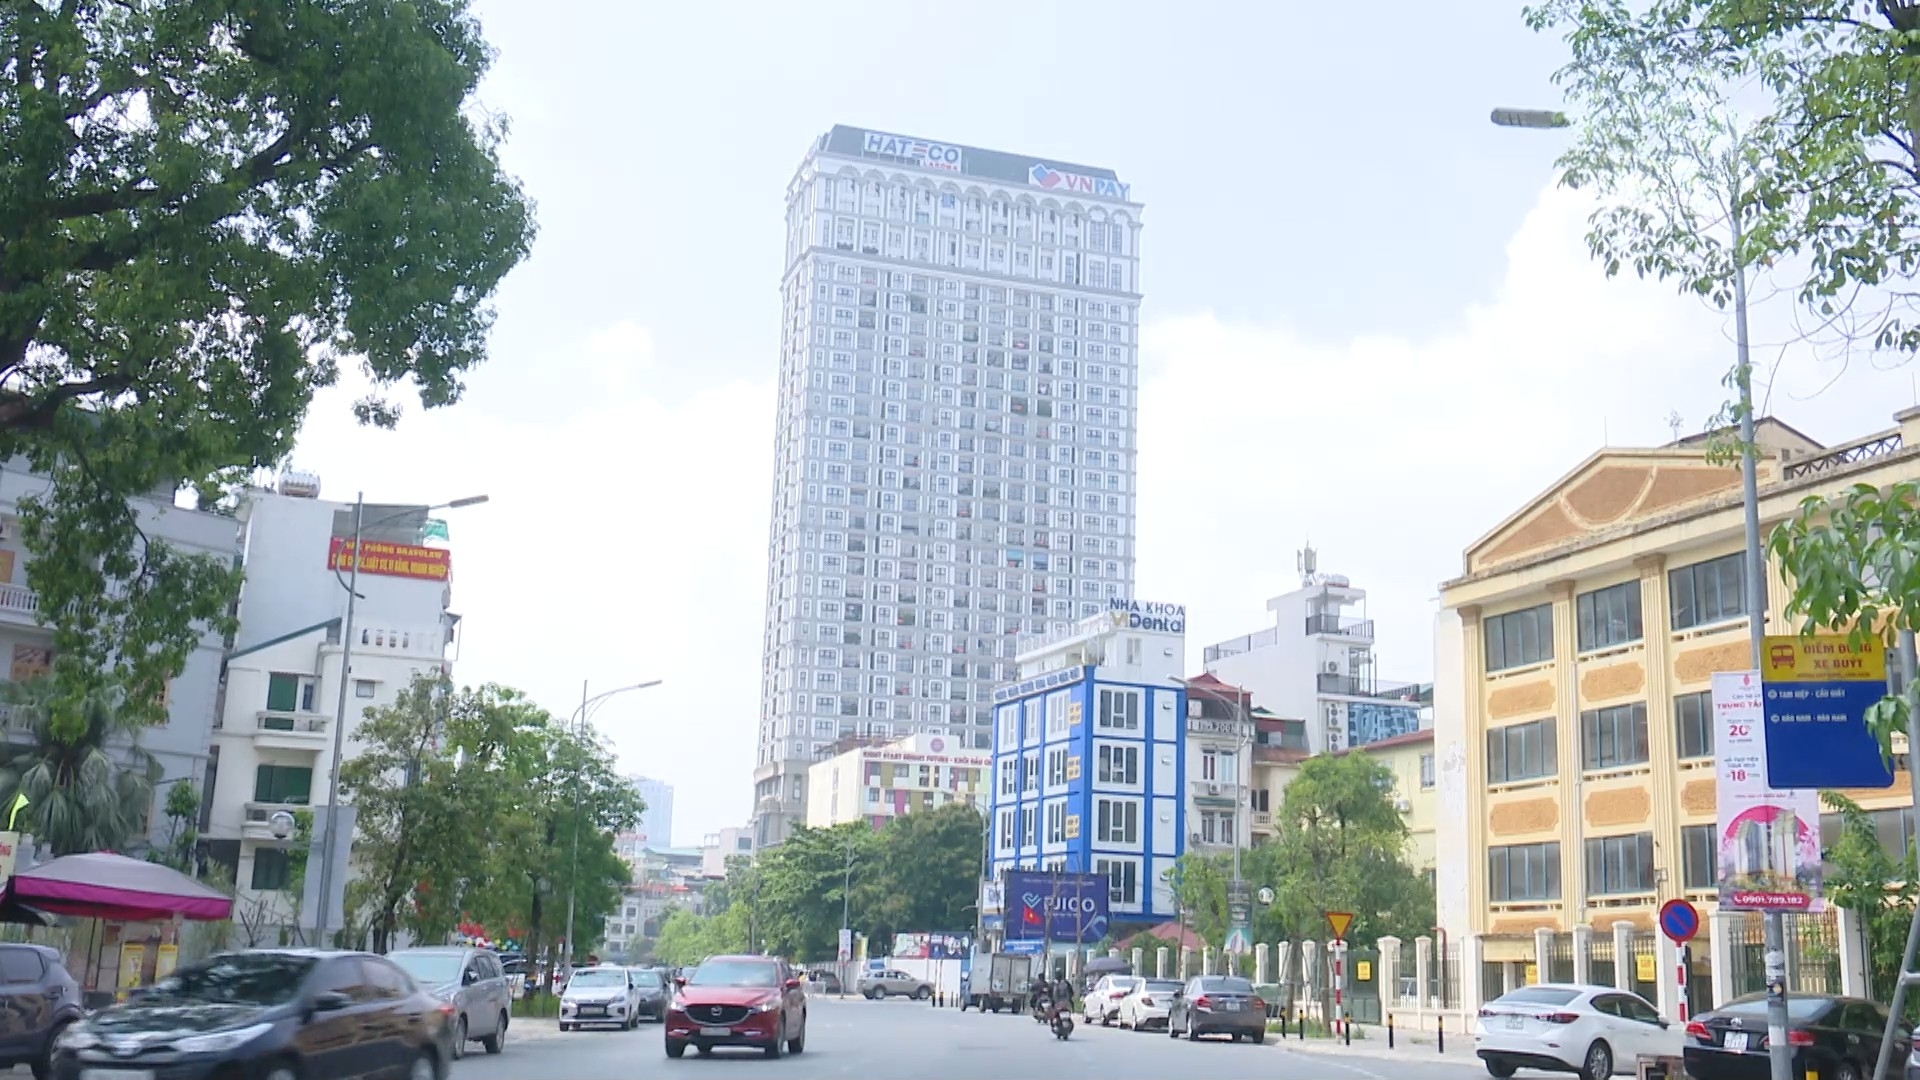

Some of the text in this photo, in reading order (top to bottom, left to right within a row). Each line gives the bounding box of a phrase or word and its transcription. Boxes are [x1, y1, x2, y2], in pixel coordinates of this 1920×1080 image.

[867, 134, 959, 163] HATECO
[1065, 174, 1130, 202] VNPAY
[1110, 597, 1185, 616] NHA KHOA
